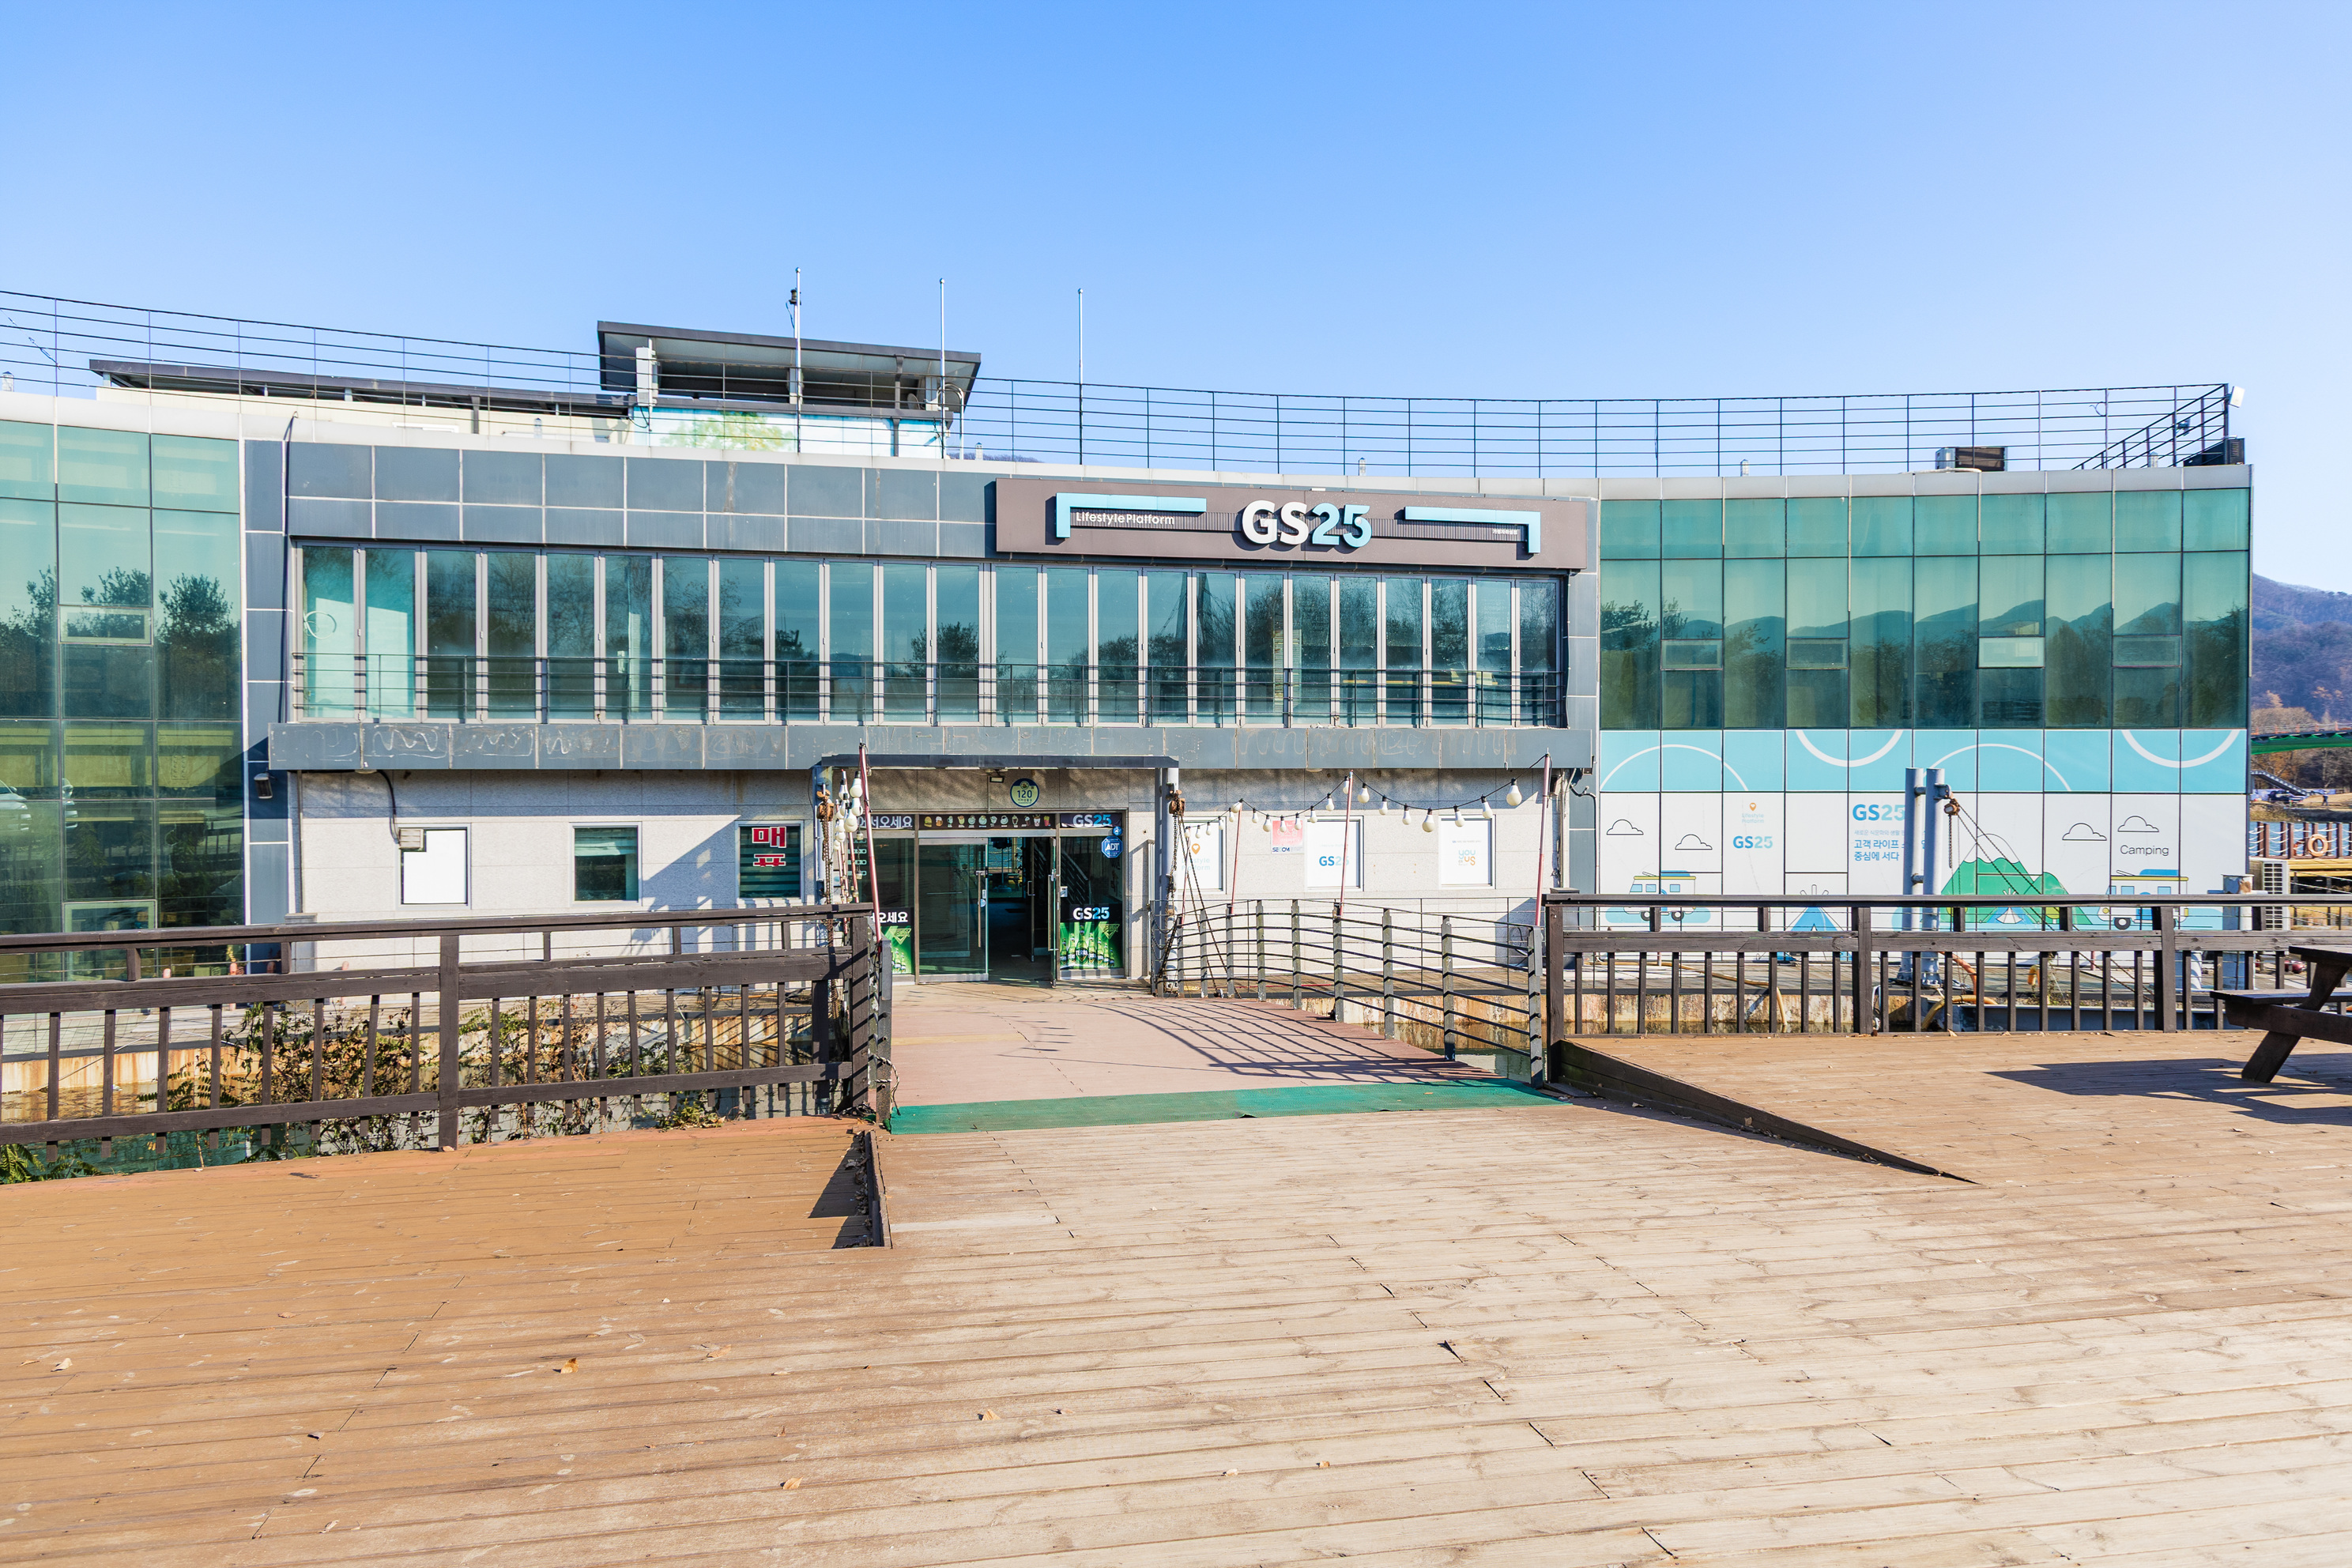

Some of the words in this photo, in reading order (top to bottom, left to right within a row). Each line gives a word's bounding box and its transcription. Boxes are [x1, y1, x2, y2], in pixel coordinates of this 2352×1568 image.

[1242, 499, 1372, 548] GS25
[1853, 804, 1905, 821] GS25
[858, 816, 913, 828] 어서오세요
[1072, 814, 1112, 827] GS25
[1105, 842, 1120, 851] ADT
[1732, 835, 1773, 849] GS25
[1854, 839, 1871, 849] 고객
[1873, 839, 1899, 849] 라이프
[1854, 851, 1880, 861] 중심에
[1882, 851, 1900, 861] 서다
[2120, 844, 2169, 857] Camping
[1072, 906, 1110, 921] GS25
